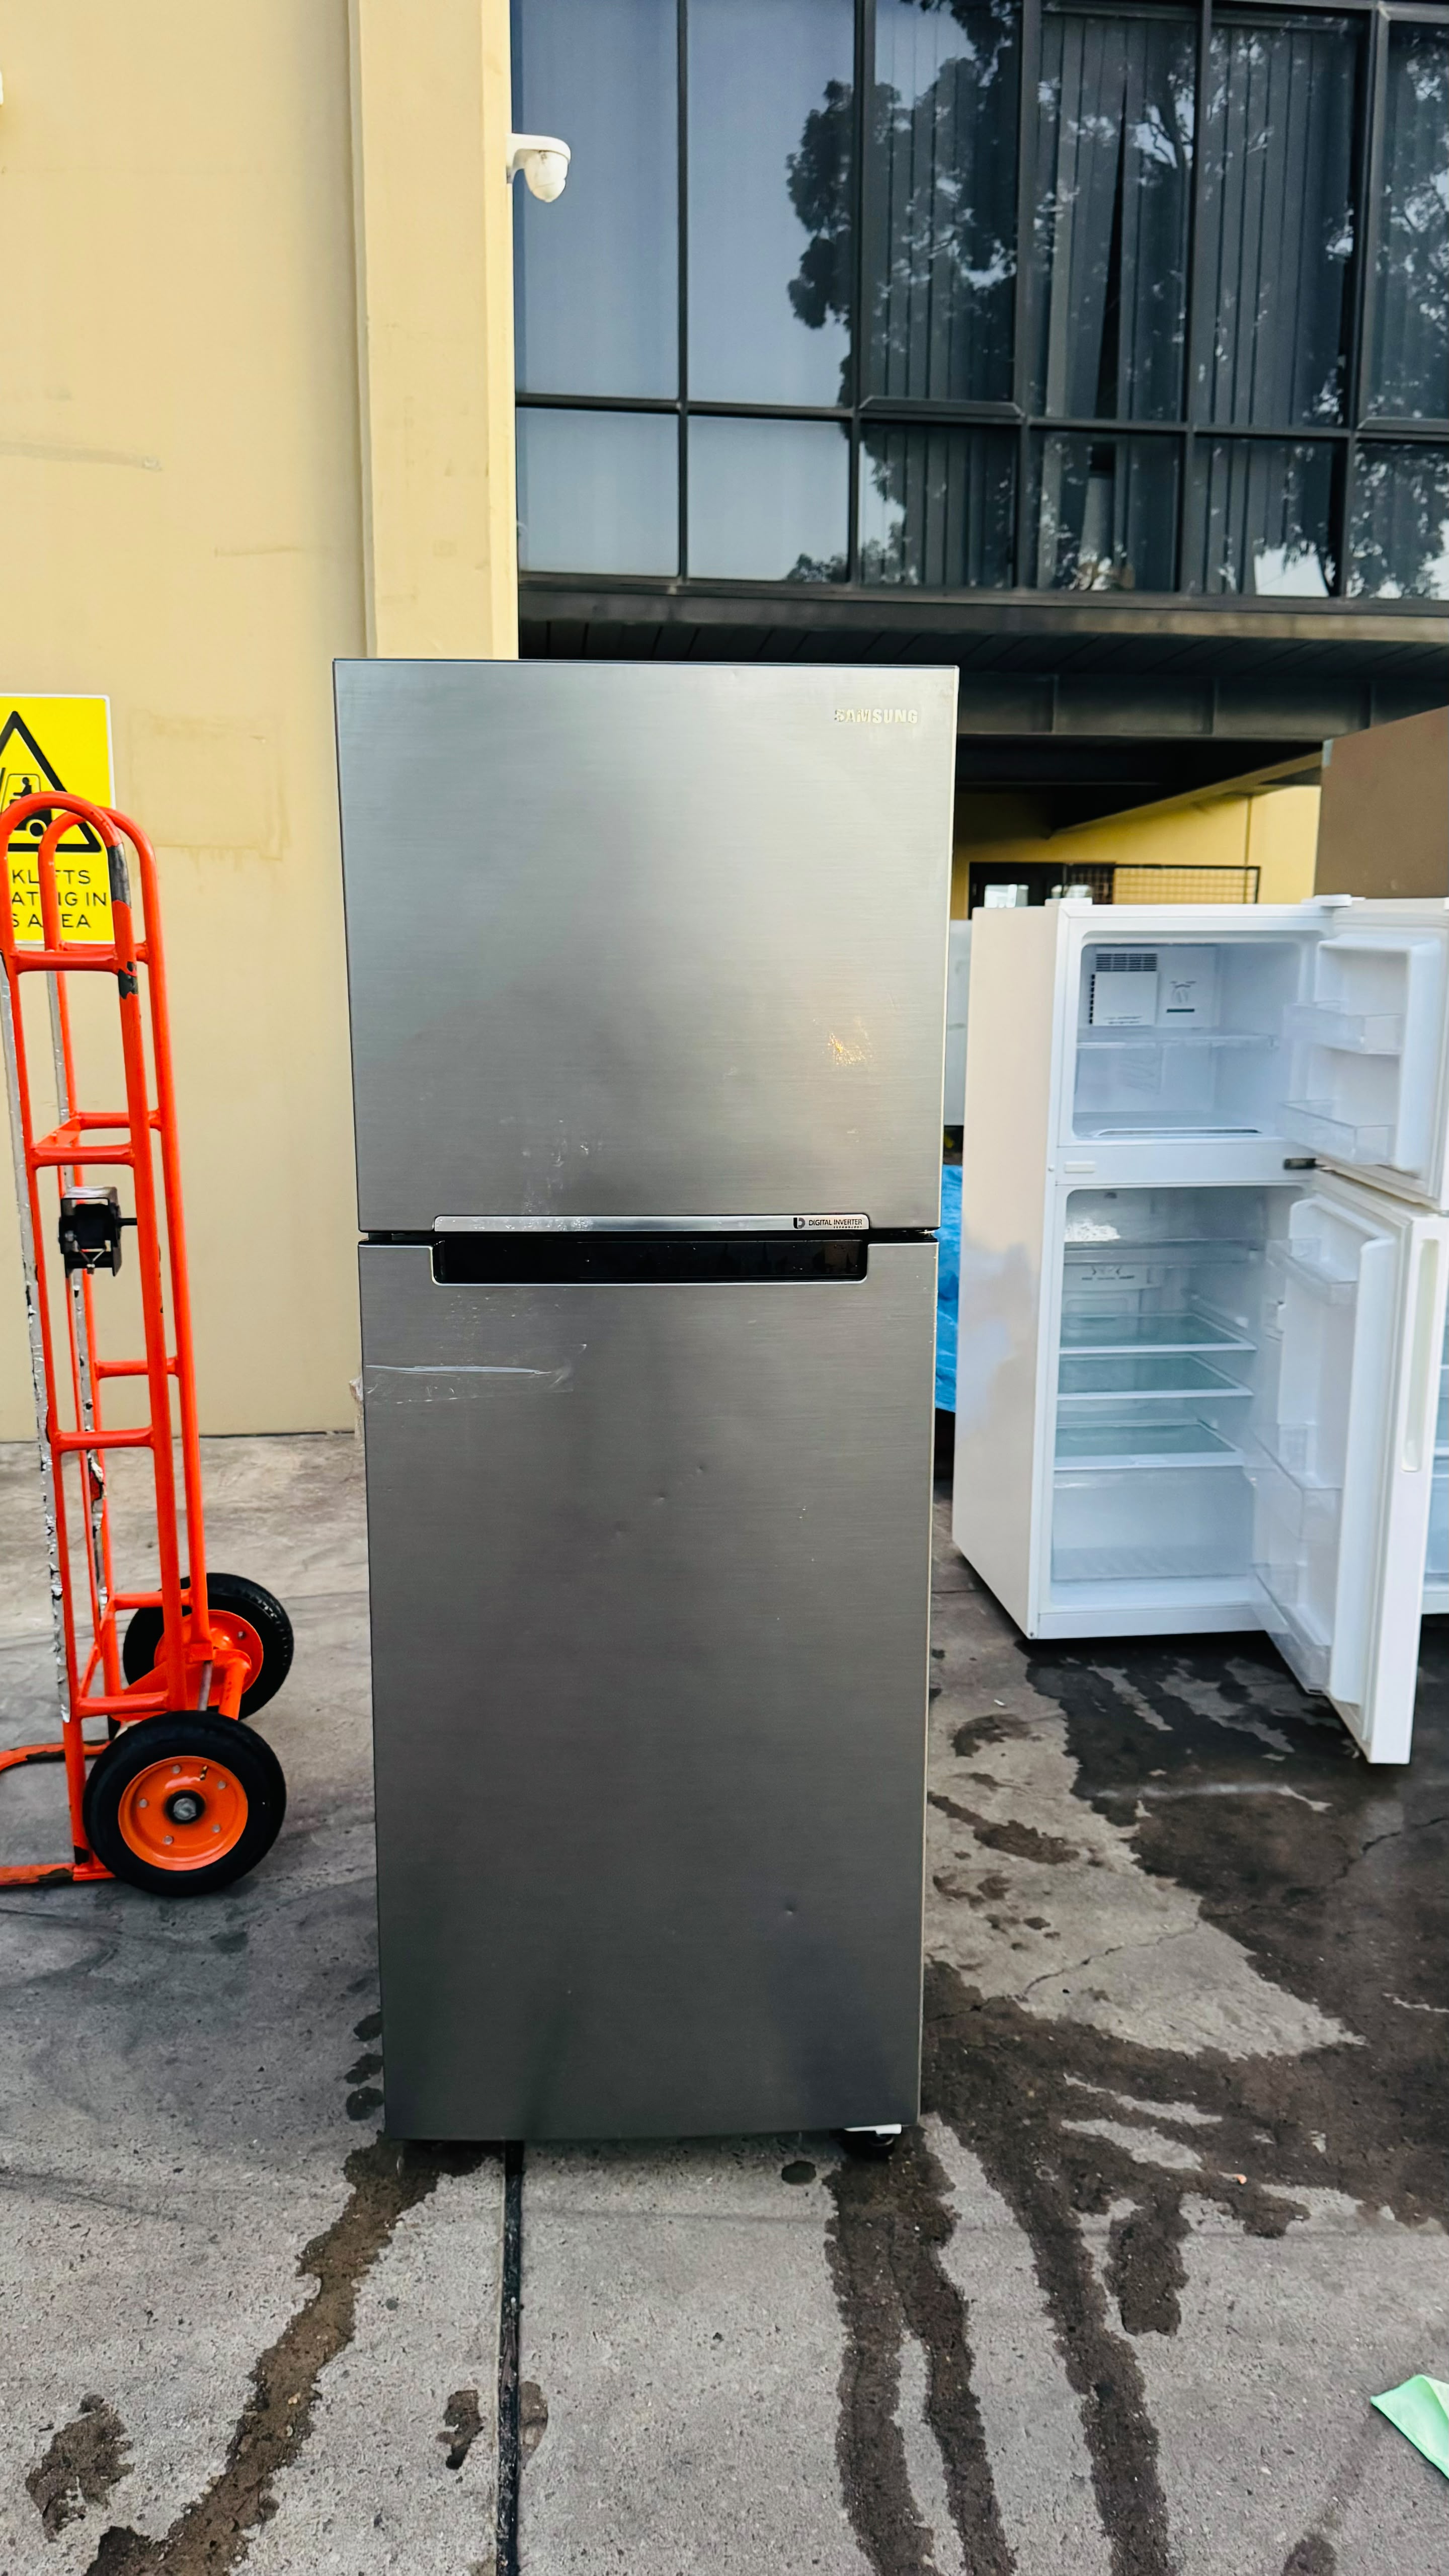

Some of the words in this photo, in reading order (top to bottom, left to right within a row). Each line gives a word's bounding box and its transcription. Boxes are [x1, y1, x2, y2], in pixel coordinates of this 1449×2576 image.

[834, 708, 918, 723] SAMSUNG
[87, 892, 106, 906] IN
[28, 914, 91, 928] AEA
